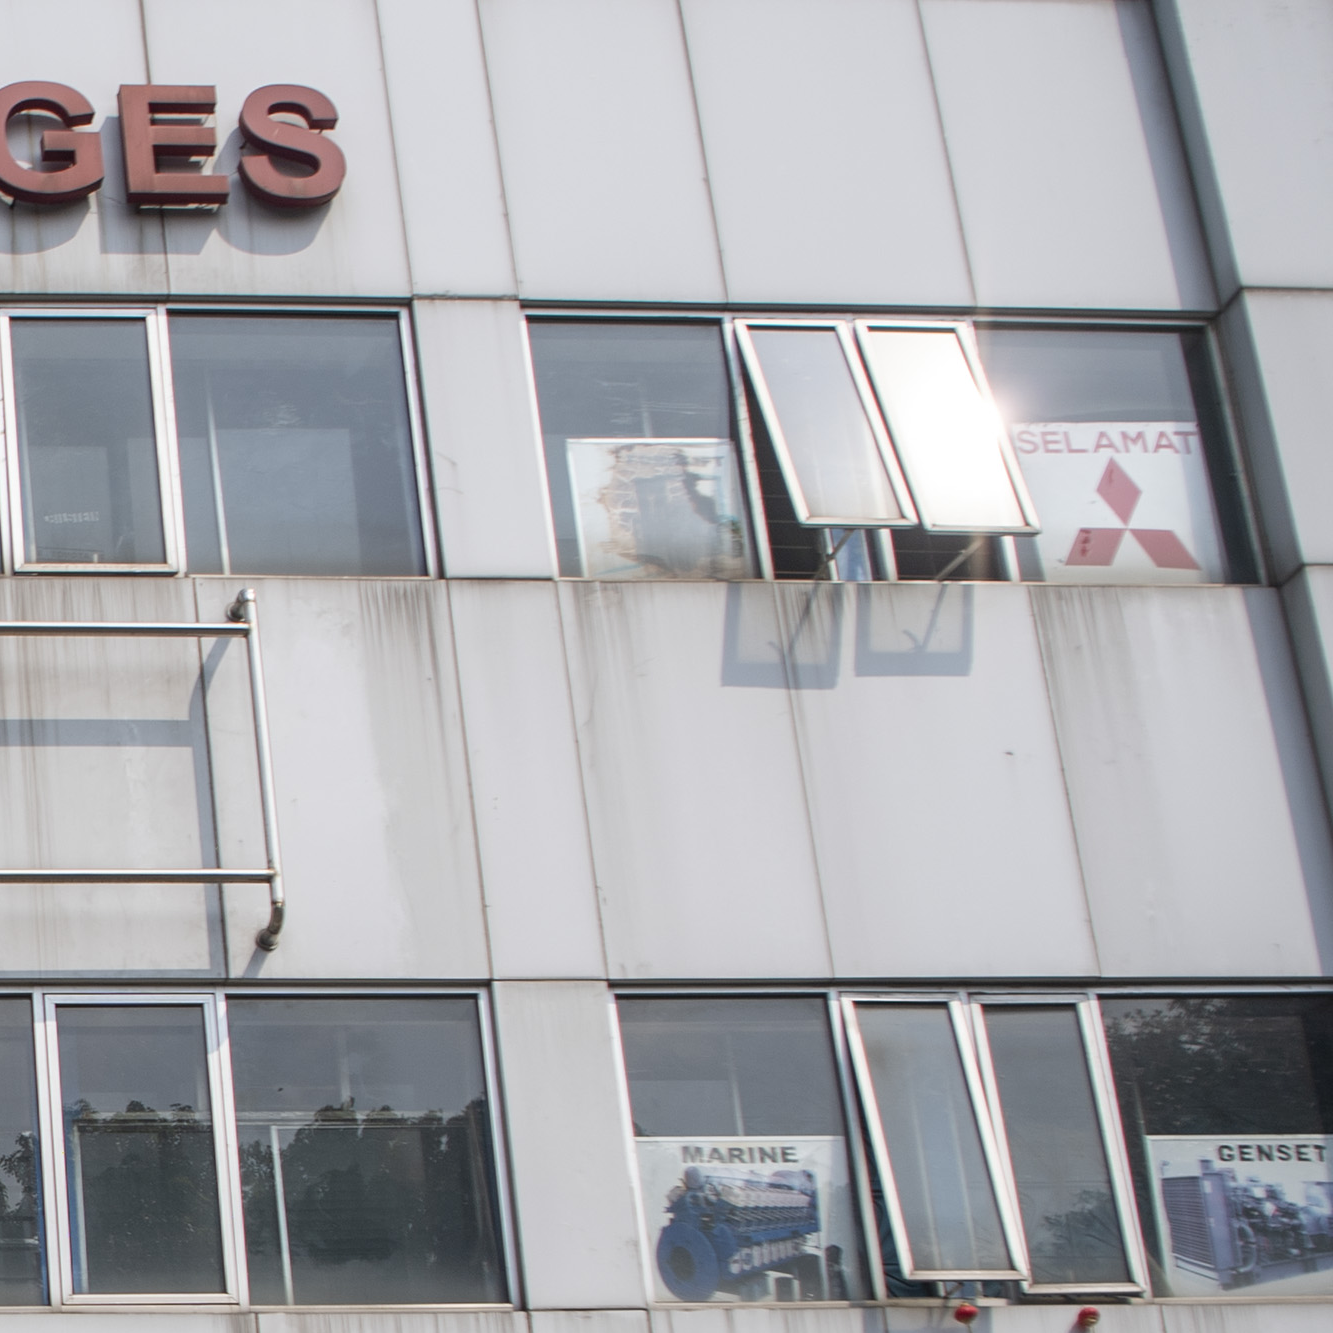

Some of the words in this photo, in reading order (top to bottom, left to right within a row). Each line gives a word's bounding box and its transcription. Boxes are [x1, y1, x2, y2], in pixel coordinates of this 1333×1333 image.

[1016, 431, 1199, 454] SELAMAT
[682, 1145, 799, 1164] MARINE
[1218, 1145, 1327, 1162] GENSET
